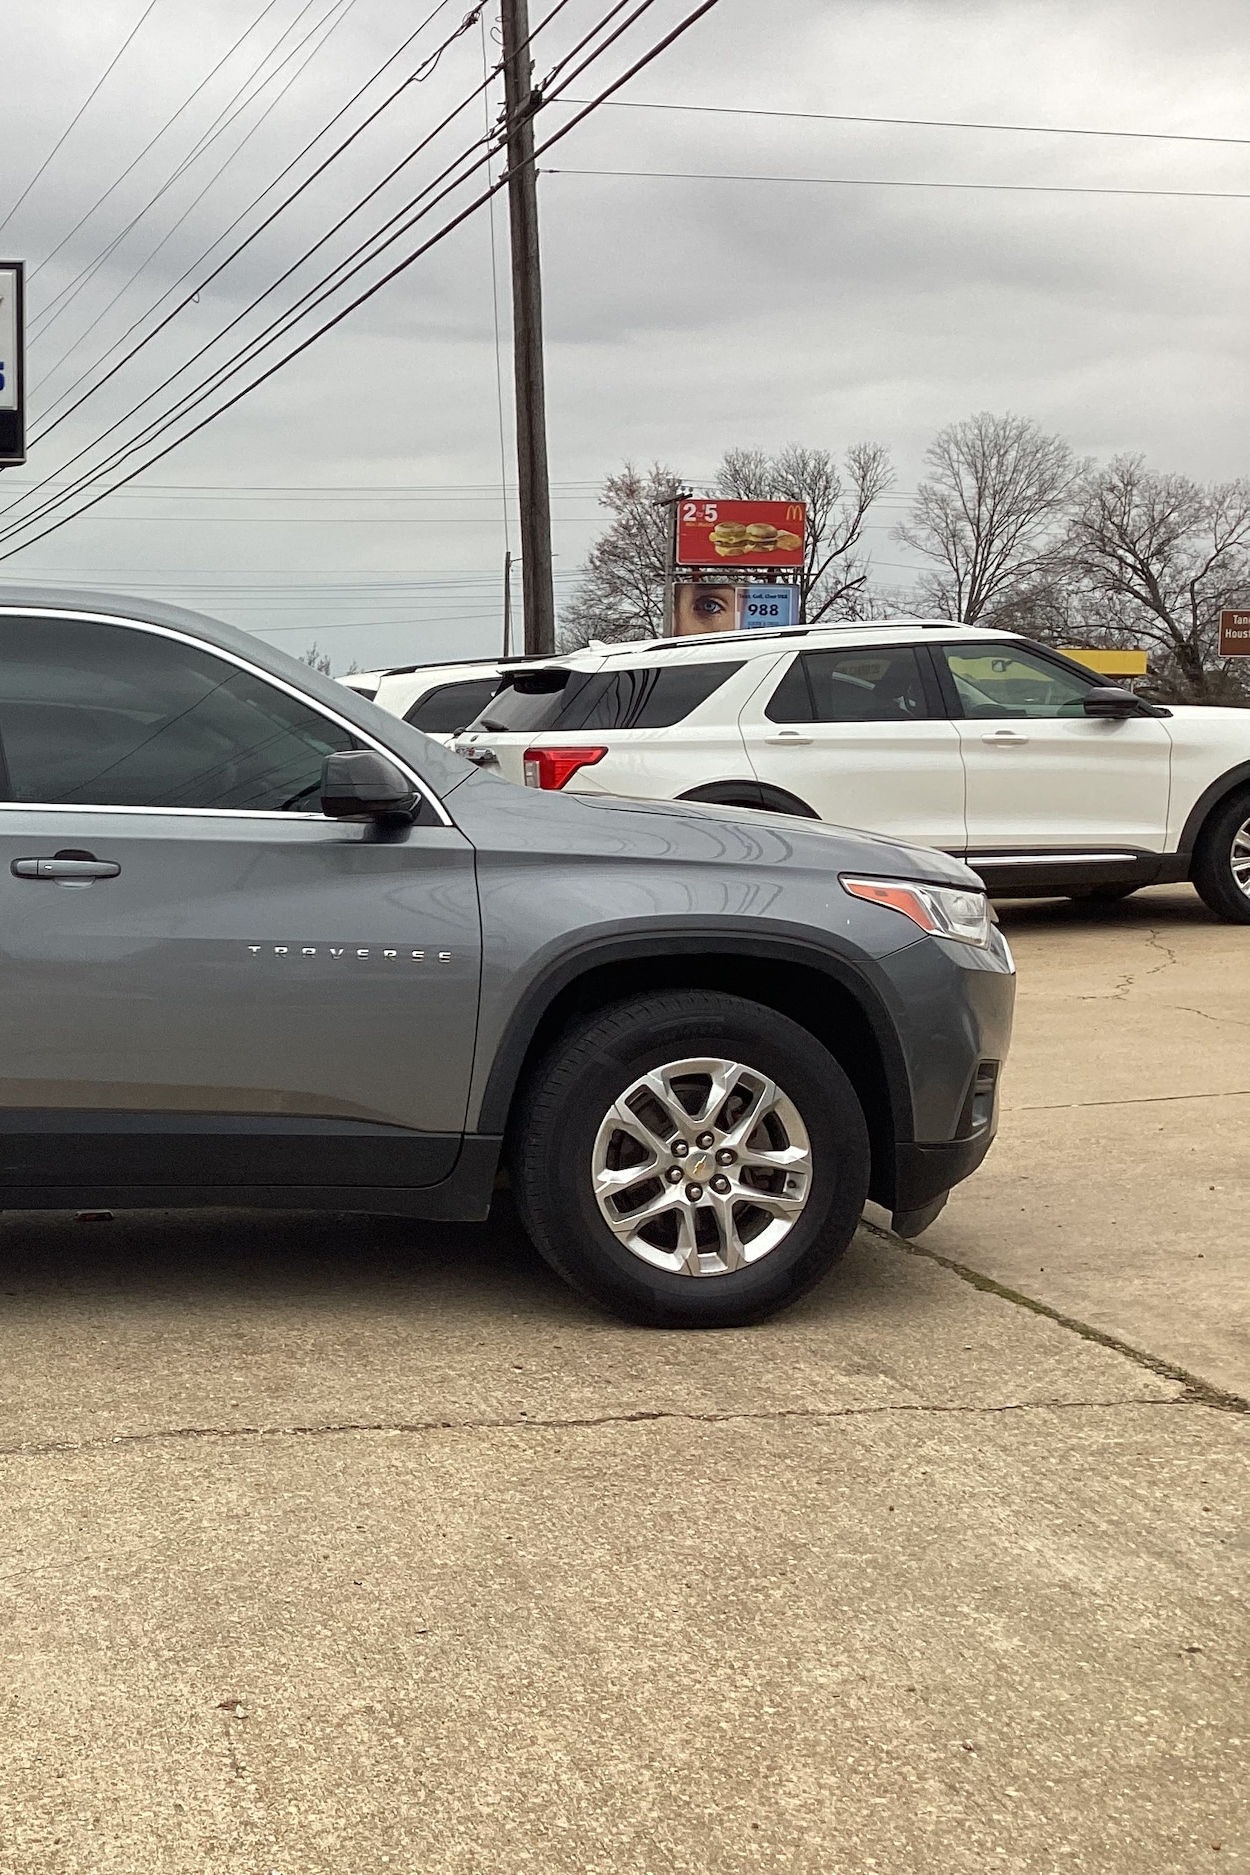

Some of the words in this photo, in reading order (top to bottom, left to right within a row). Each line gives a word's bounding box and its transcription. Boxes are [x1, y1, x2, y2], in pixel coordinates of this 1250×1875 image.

[683, 502, 697, 522] 2
[747, 603, 779, 616] 988
[1225, 628, 1250, 639] Hous
[247, 945, 452, 963] TRAVERSE
